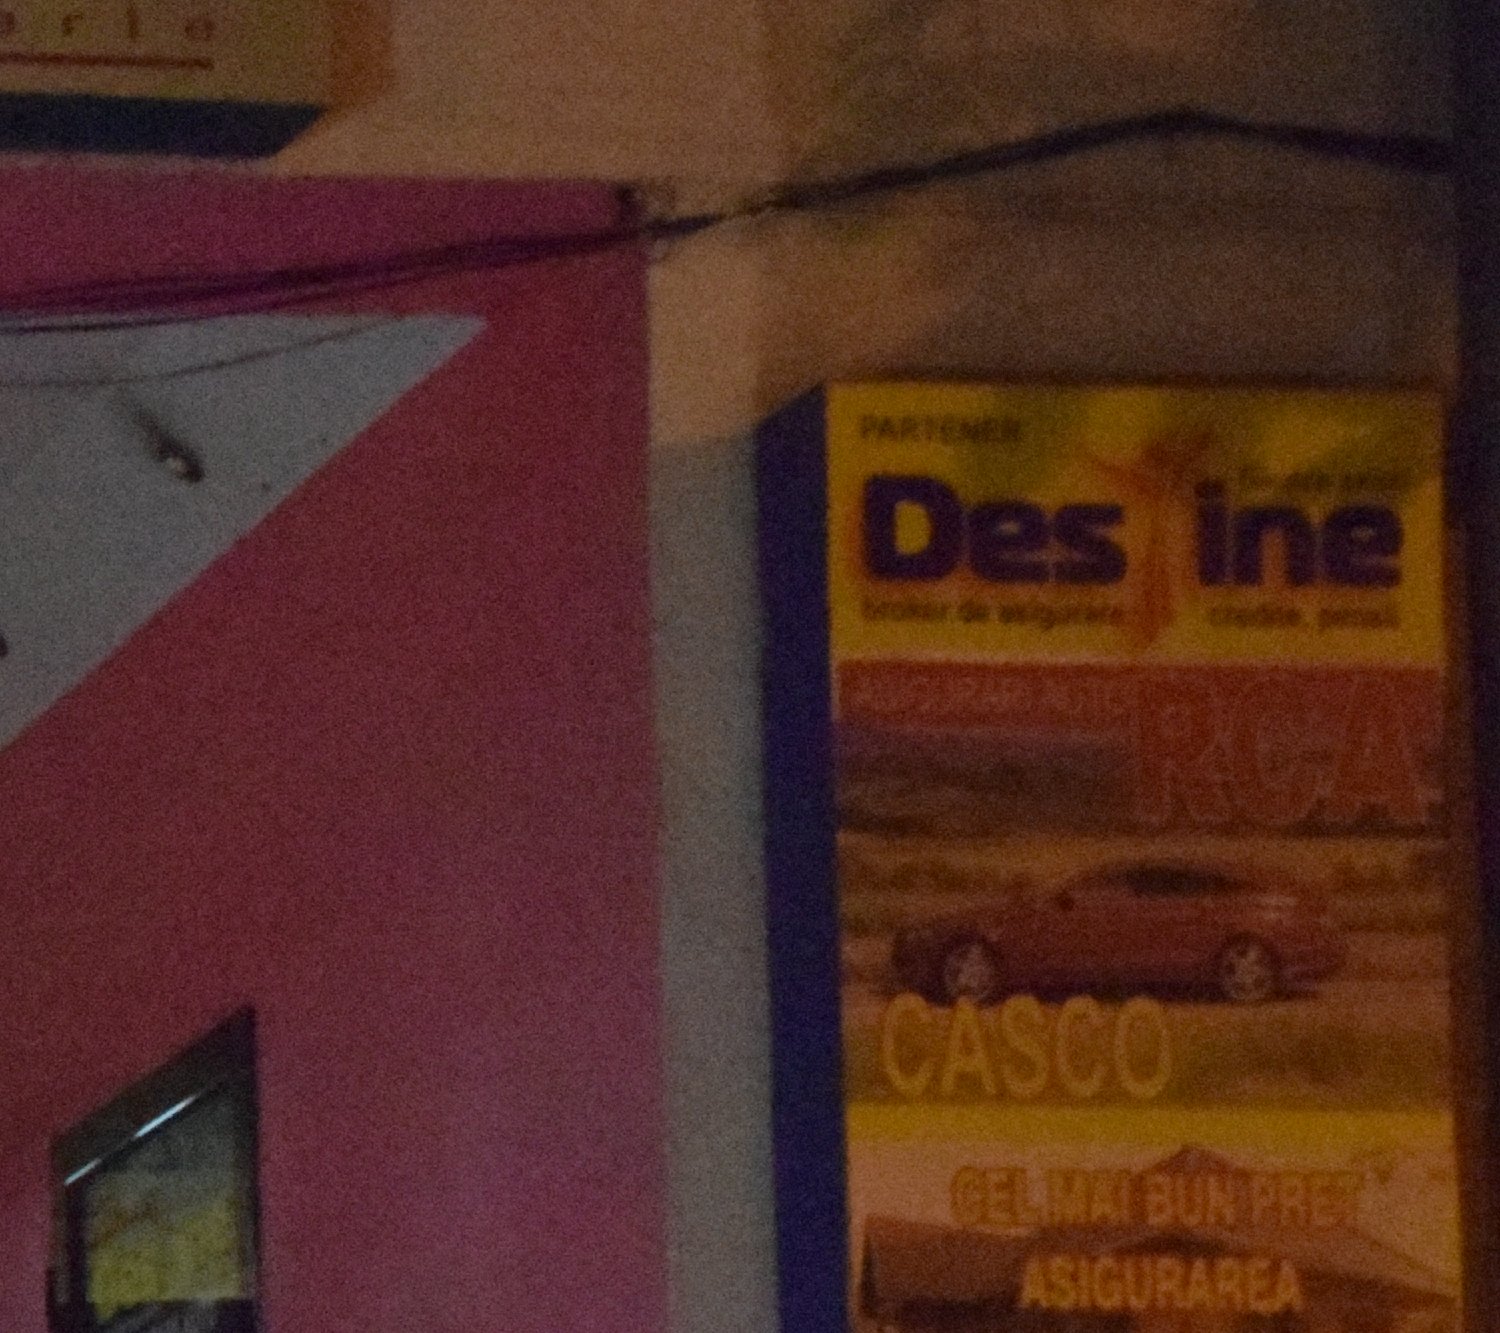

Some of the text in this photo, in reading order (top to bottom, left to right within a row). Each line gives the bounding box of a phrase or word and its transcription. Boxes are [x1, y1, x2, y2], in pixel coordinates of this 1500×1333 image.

[882, 990, 1172, 1099] CASCO
[1145, 1171, 1237, 1229] BUN
[1020, 1254, 1302, 1312] ASIGURAREA
